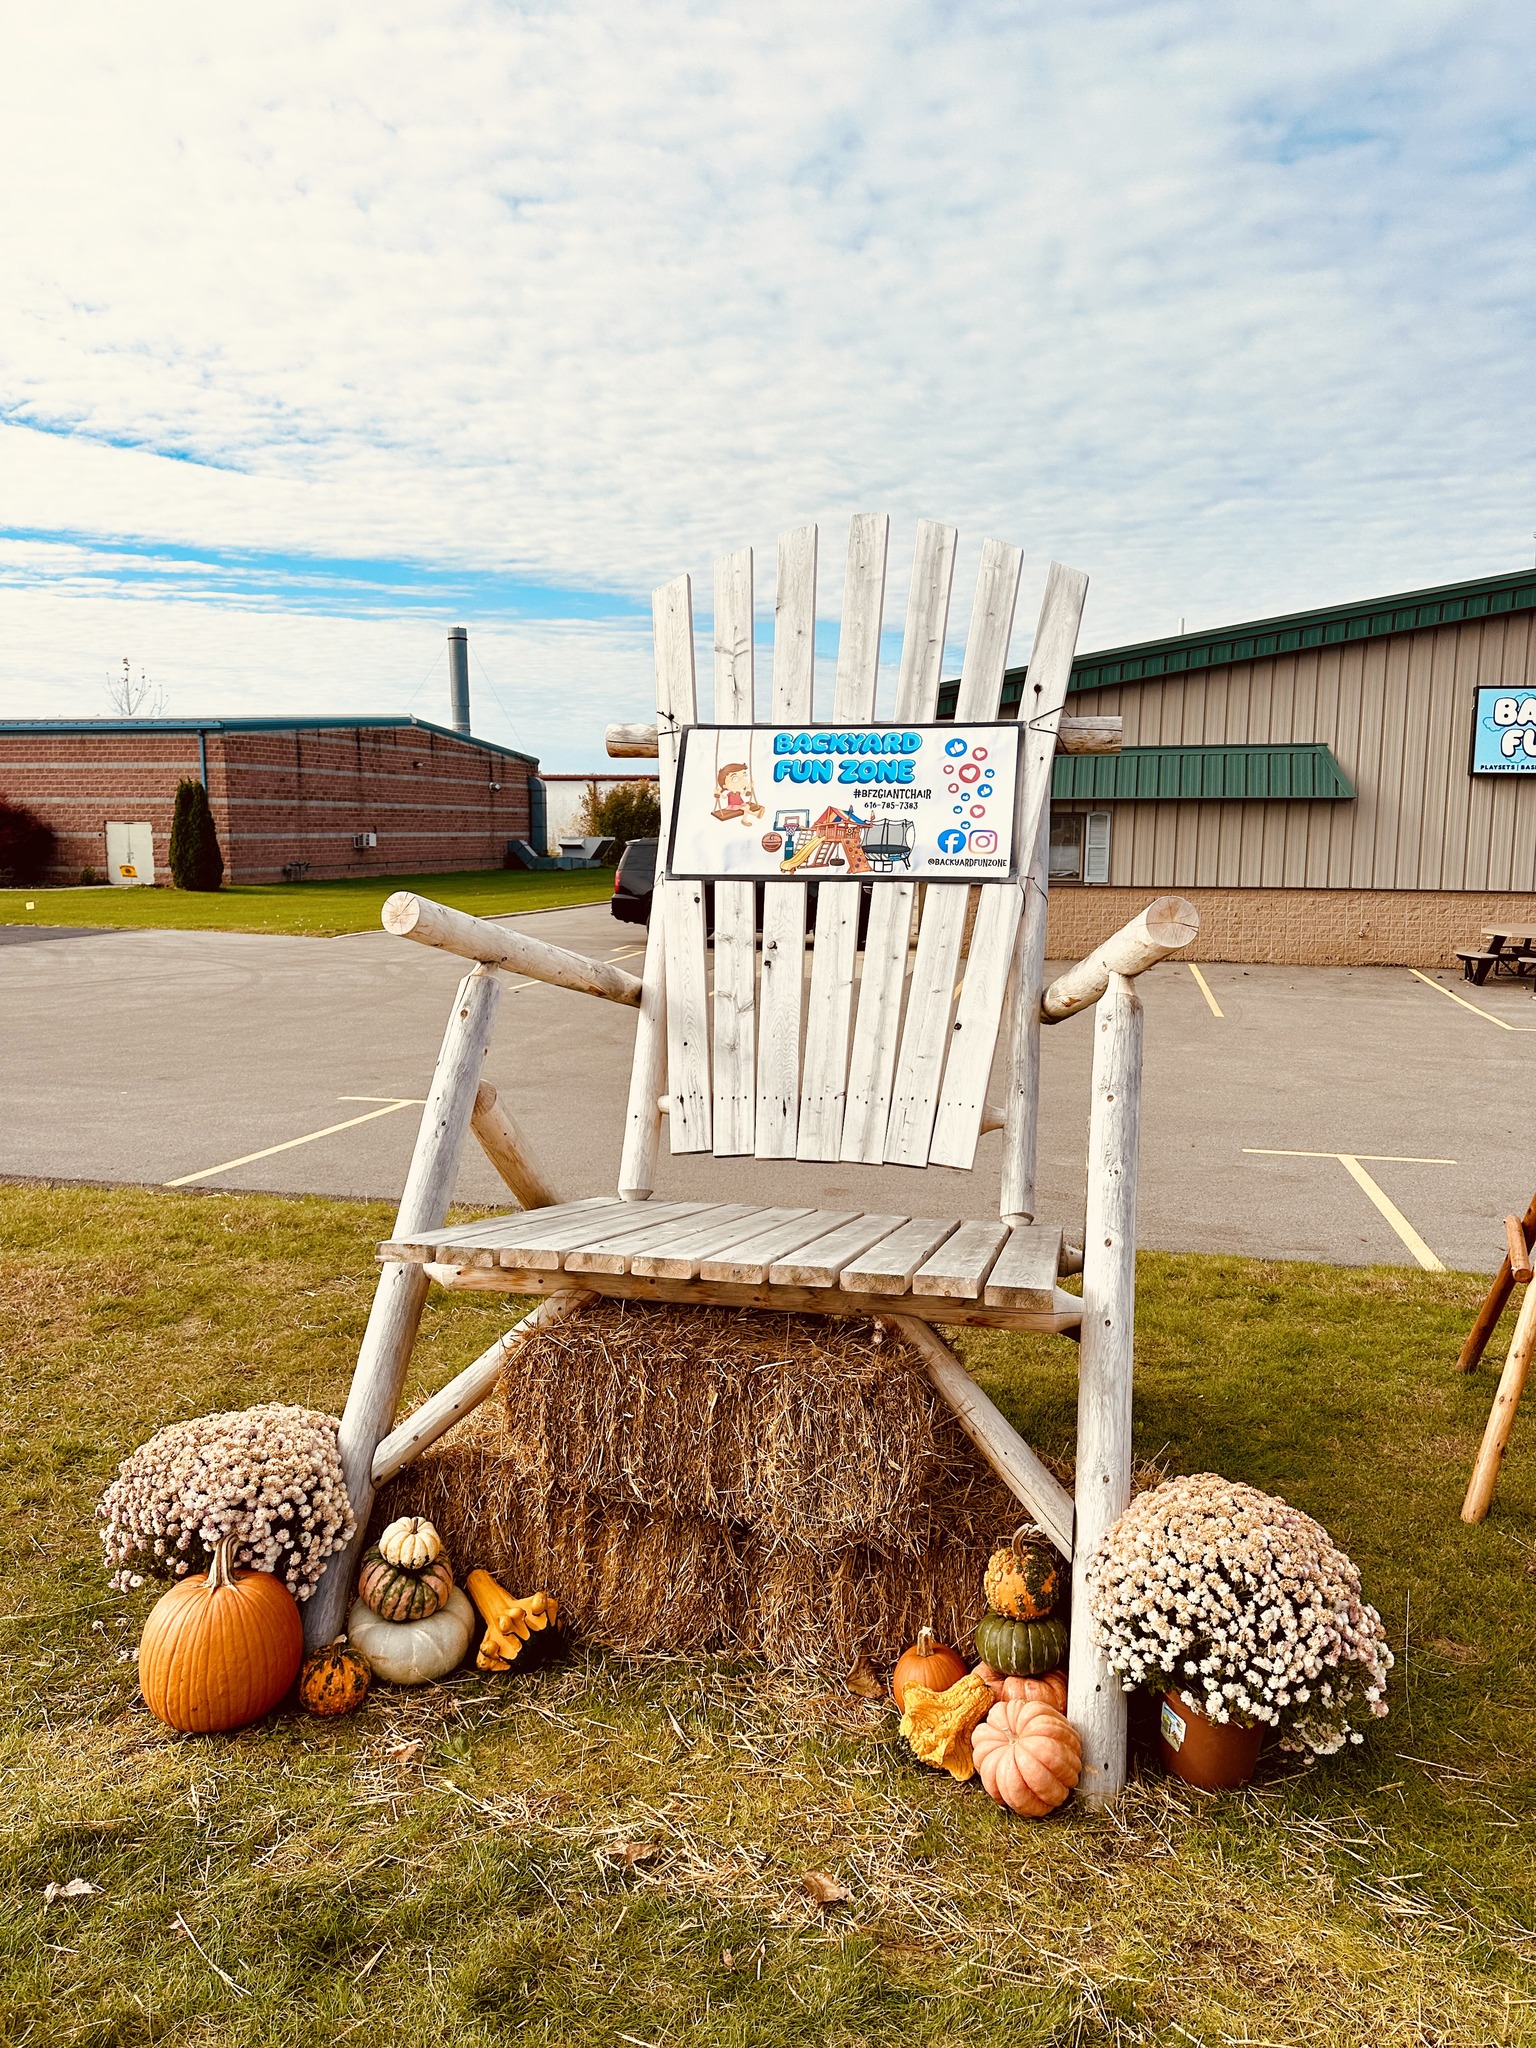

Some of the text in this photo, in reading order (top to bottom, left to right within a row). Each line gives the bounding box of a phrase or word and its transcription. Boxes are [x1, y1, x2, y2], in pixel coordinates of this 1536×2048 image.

[773, 732, 923, 755] BACKYARD
[773, 759, 917, 784] FUN ZONE
[853, 788, 932, 799] #BFZGIANTCHAIR
[864, 801, 919, 810] 616-785-7383
[927, 858, 1008, 867] @BACKYARDFUNZONE
